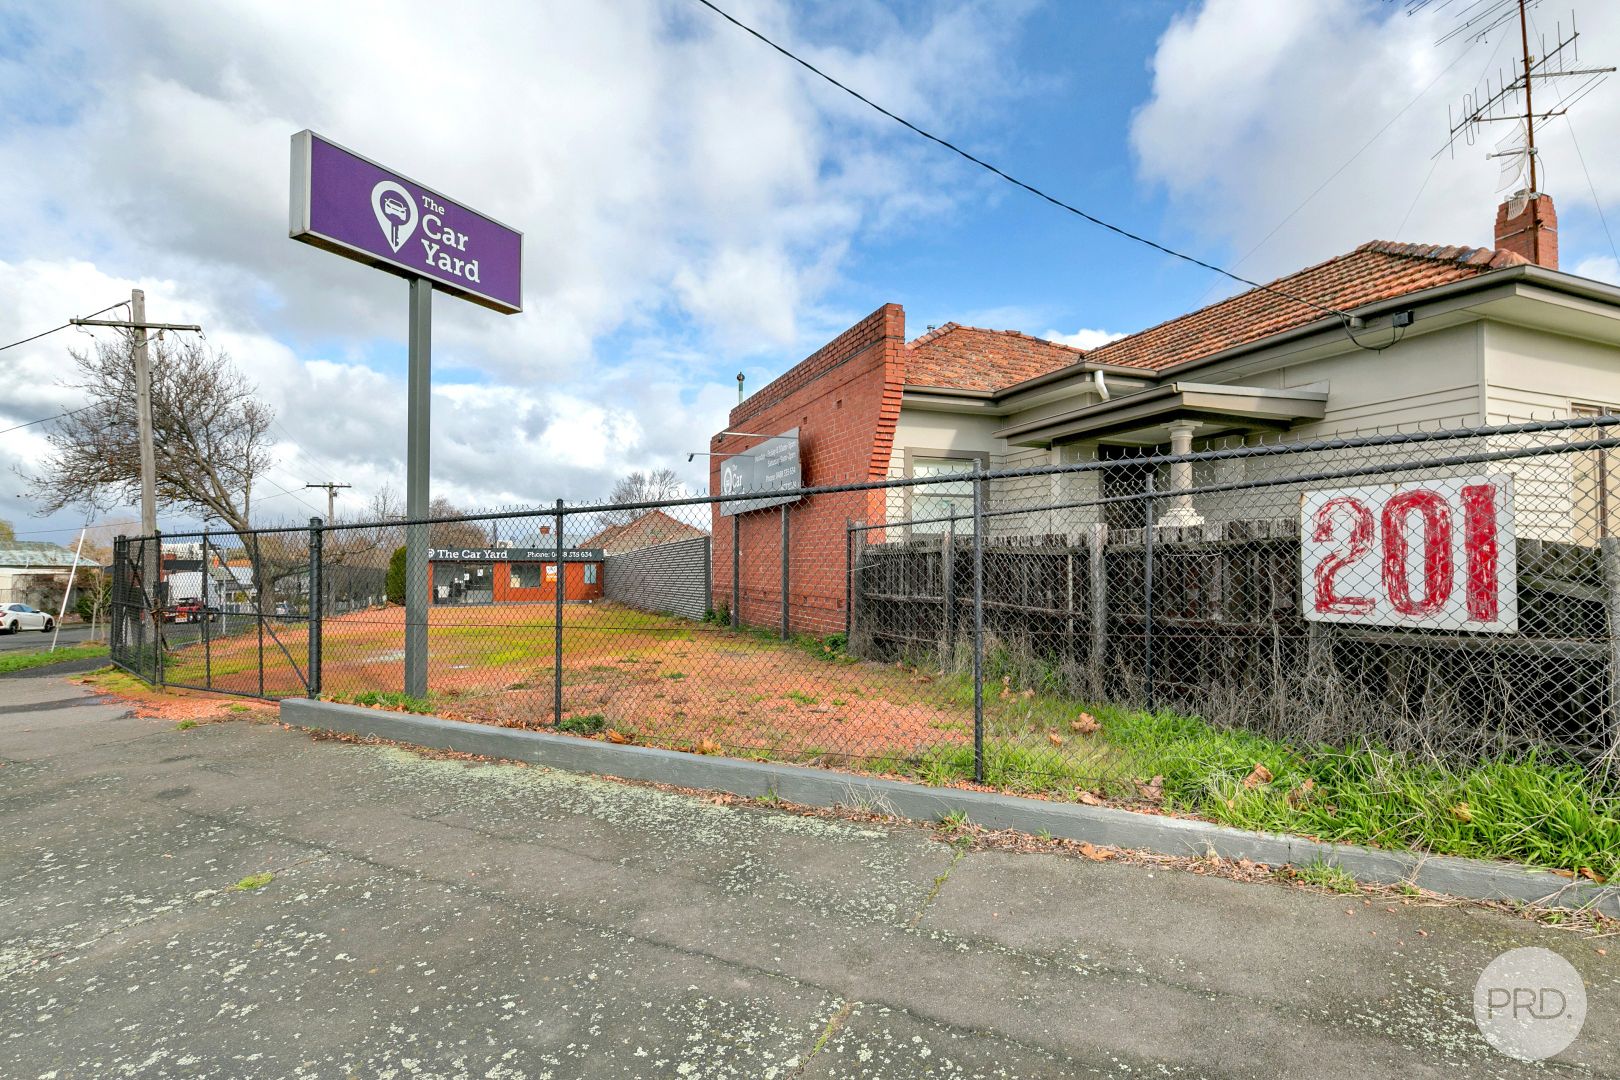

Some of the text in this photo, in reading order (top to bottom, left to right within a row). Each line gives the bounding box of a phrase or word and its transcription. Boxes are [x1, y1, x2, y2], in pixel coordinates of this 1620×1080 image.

[422, 195, 445, 215] The
[421, 214, 469, 252] Car
[421, 238, 481, 283] Yard
[733, 473, 742, 488] Car
[437, 549, 508, 559] The Car Yard
[1312, 483, 1498, 623] 201
